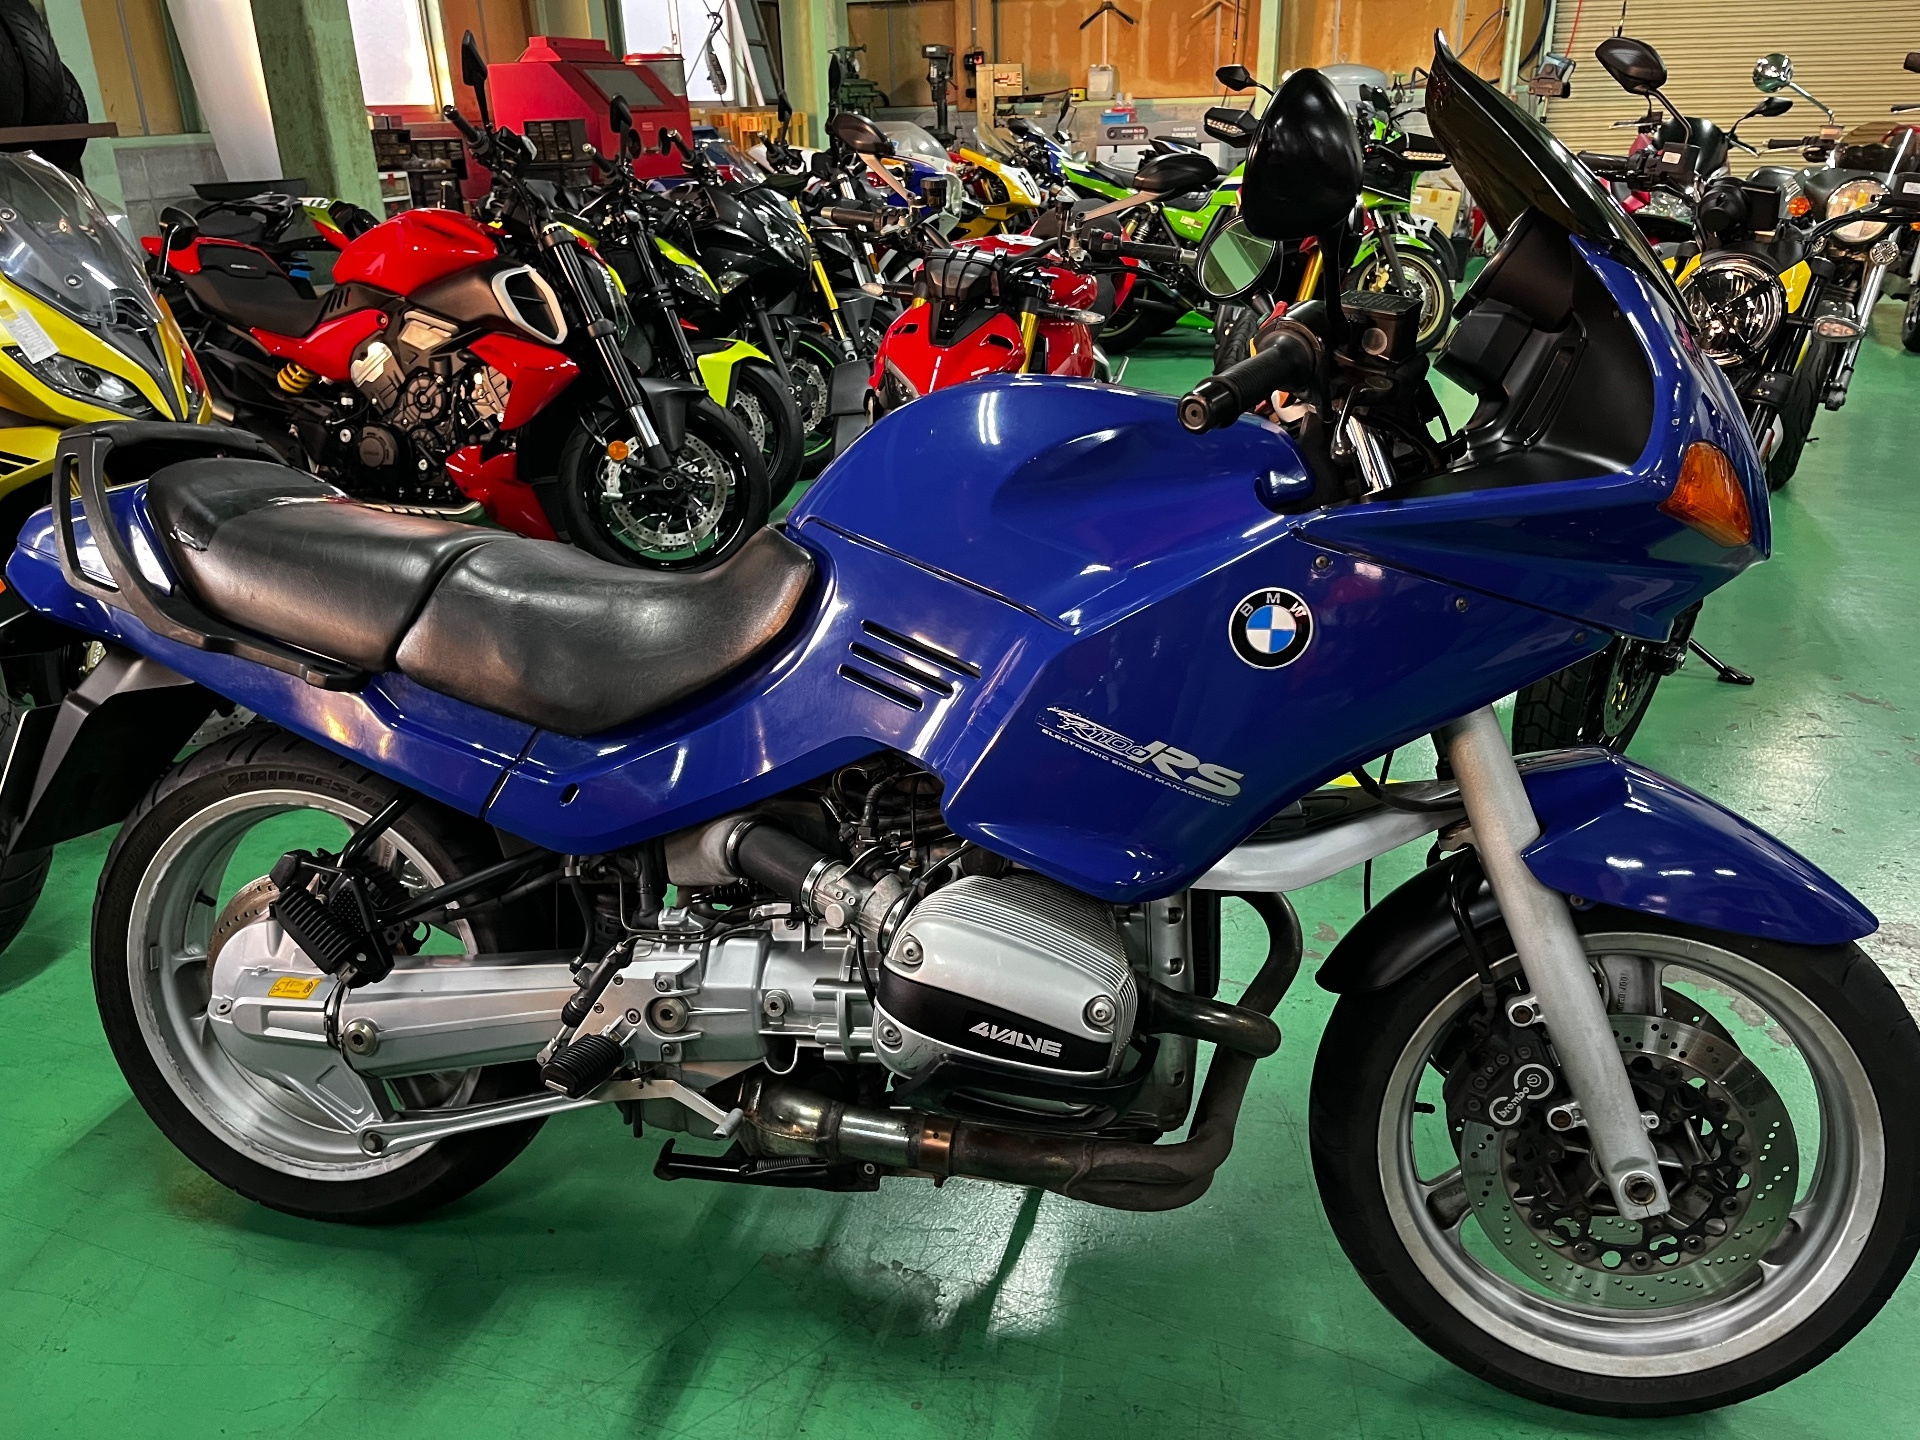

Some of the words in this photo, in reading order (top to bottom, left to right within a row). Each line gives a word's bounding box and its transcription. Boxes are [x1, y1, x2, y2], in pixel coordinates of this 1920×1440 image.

[1239, 592, 1307, 618] BMW
[1041, 728, 1110, 761] ELECTRONIC
[1111, 759, 1153, 780] ENGINE
[1155, 777, 1232, 807] MANAGEMENT
[1497, 1086, 1530, 1119] brembo
